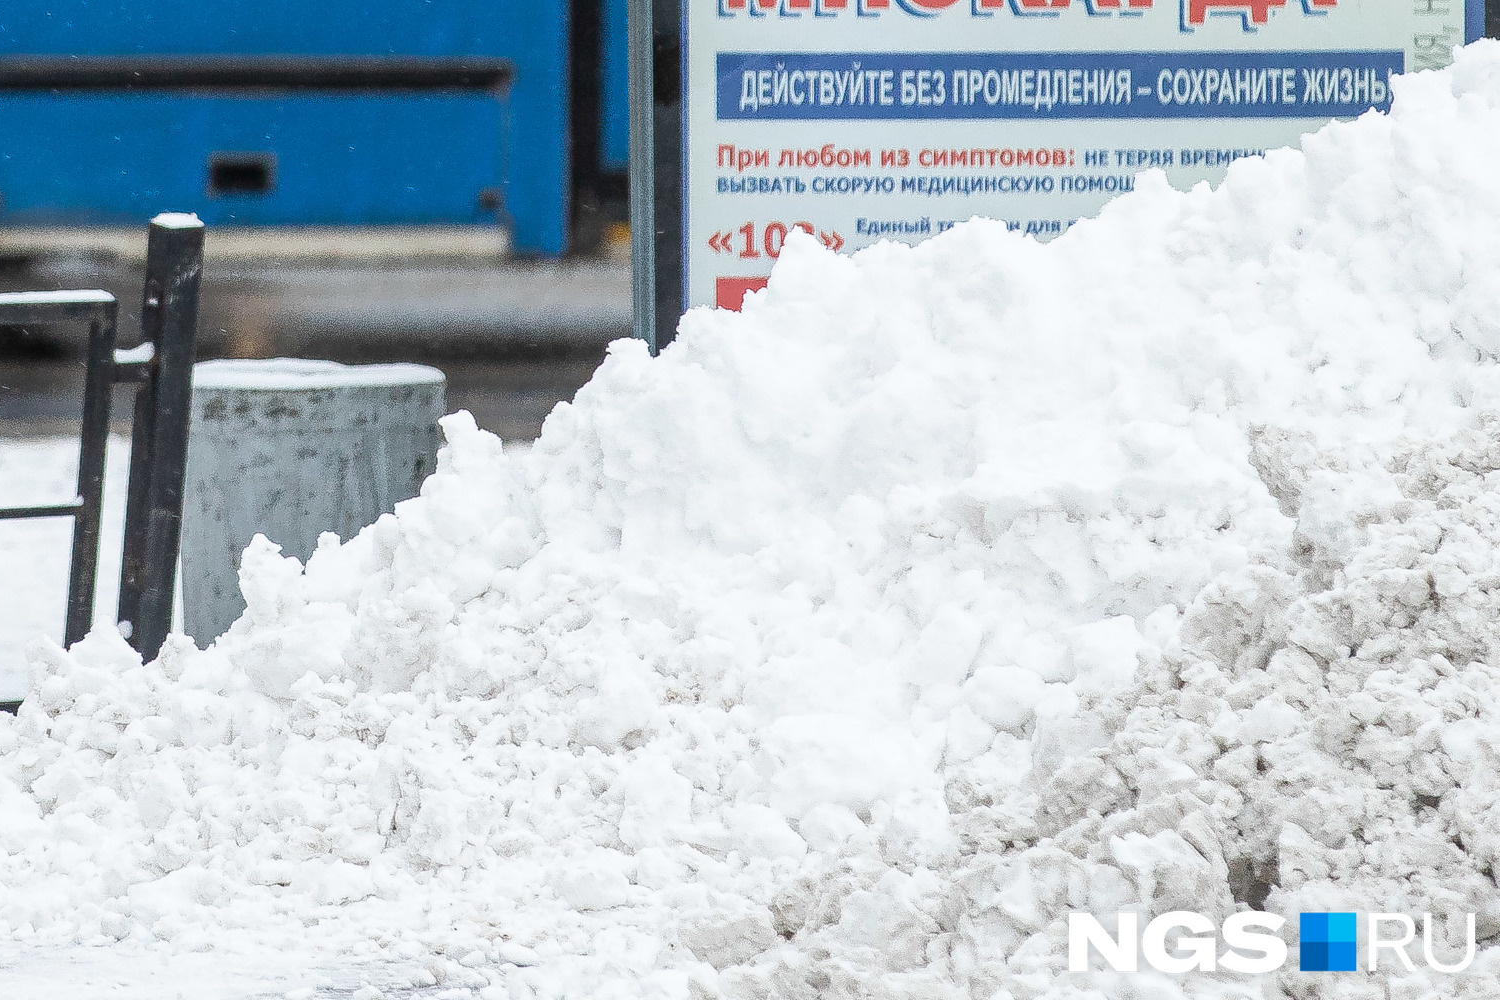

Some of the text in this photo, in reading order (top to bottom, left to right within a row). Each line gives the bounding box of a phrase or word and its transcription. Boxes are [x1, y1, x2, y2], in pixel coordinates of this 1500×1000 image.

[739, 62, 894, 111] ДЕЙСТВУЙТЕ
[900, 70, 946, 105] БЕЗ
[953, 69, 1132, 111] ПРОМЕДЛЕНИЯ
[1157, 68, 1296, 104] СОХРАНИТЕ
[718, 145, 769, 172] При
[778, 144, 871, 167] любом
[881, 149, 910, 167] из
[918, 149, 1074, 167] симптомов:
[1085, 151, 1107, 166] НЕ
[1115, 150, 1173, 166] ТЕРЯЯ
[717, 177, 806, 193] ВЫЗВАТЬ
[812, 177, 895, 193] СКОРУЮ
[901, 176, 1054, 195] МЕДИЦИНСКУЮ
[856, 216, 931, 235] Единый
